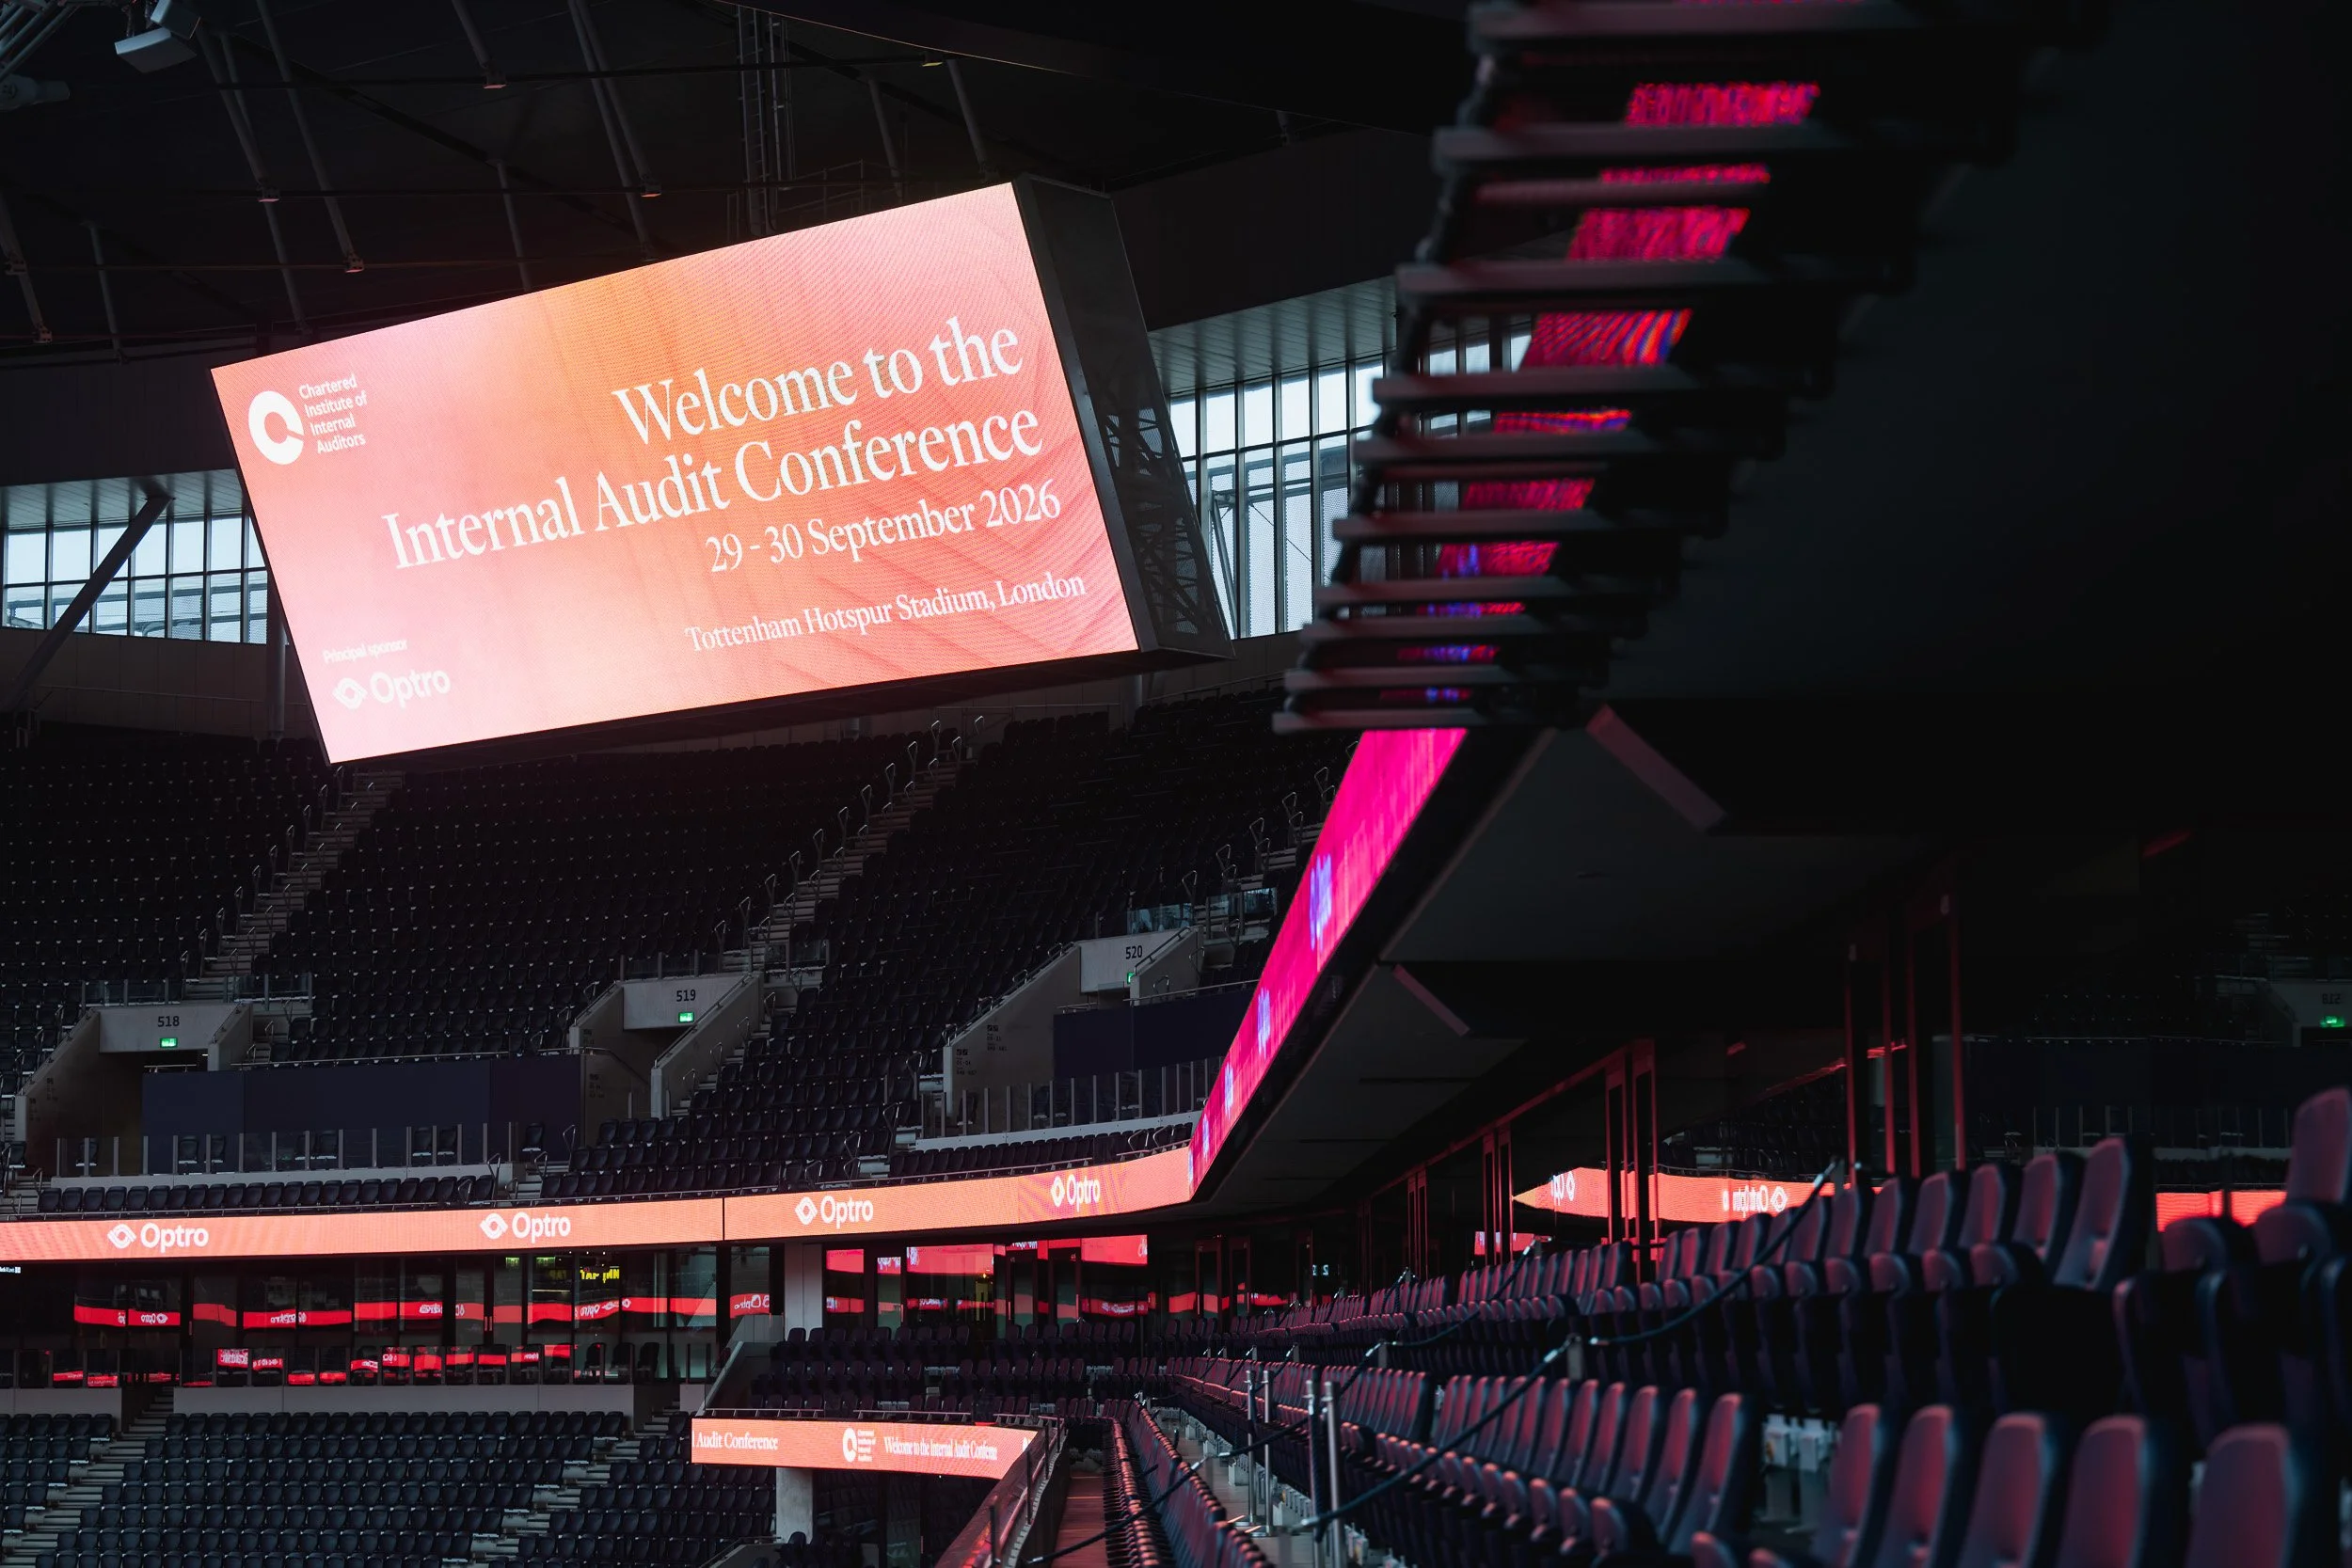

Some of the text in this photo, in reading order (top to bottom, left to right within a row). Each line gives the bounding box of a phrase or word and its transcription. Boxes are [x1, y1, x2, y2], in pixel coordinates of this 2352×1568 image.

[299, 373, 358, 399] Chartered
[612, 315, 1024, 445] Welcome to the
[304, 389, 368, 418] Institute of
[310, 412, 356, 436] Internal
[317, 434, 367, 453] Auditors
[383, 407, 1043, 569] Internal Audit Conference
[705, 532, 743, 574] 29
[764, 523, 804, 564] 30
[806, 499, 976, 562] September
[979, 478, 1061, 528] 2026
[685, 571, 1088, 652] Tottenham Hotspur Stadium, London
[370, 669, 451, 709] Optro
[1125, 944, 1143, 959] 520
[675, 989, 696, 1003] 519
[157, 1015, 180, 1028] 518
[1066, 1174, 1101, 1212] Optro
[511, 1211, 571, 1243] Optro
[819, 1195, 874, 1229] Optro
[140, 1222, 210, 1254] Optro
[696, 1430, 723, 1449] Audit
[723, 1432, 779, 1450] Conference
[883, 1436, 913, 1455] Welcome
